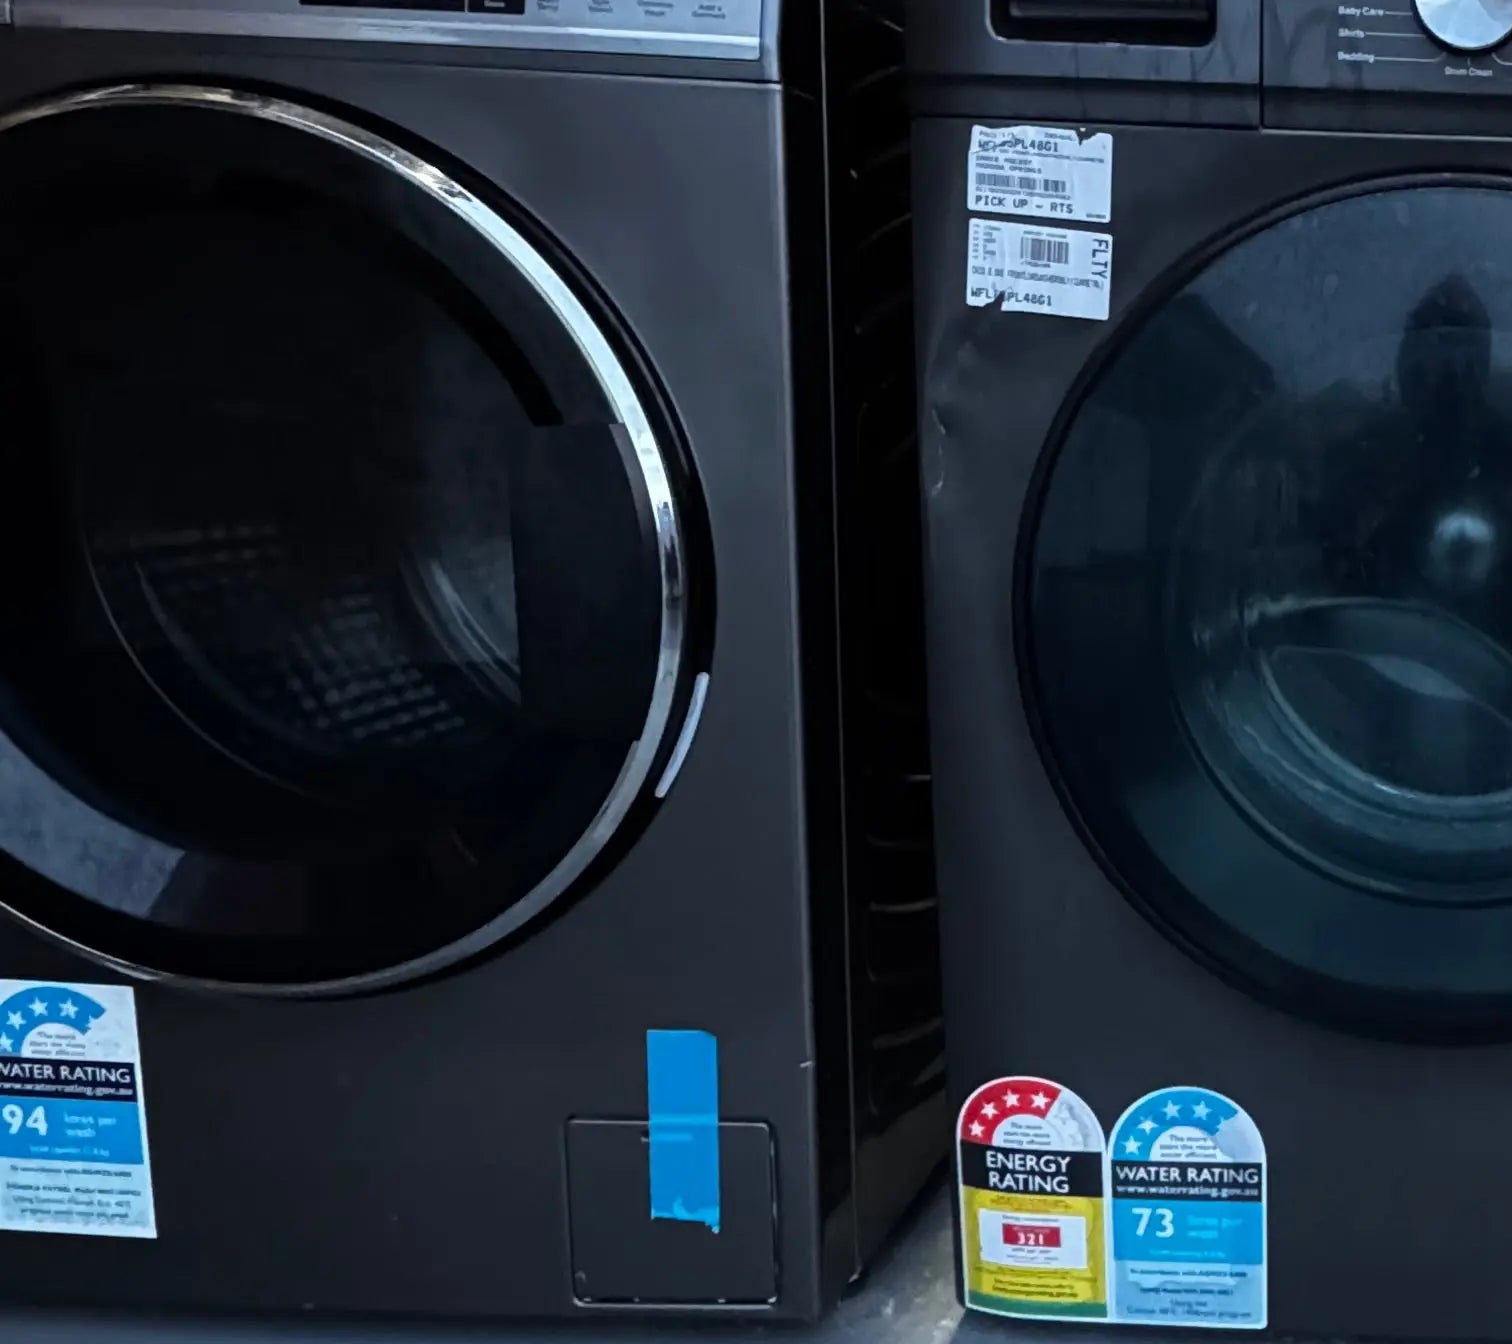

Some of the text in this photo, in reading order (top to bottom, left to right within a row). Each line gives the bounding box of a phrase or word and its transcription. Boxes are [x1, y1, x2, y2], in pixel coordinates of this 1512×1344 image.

[1338, 6, 1384, 17] Baby Care
[975, 195, 1006, 207] PICK
[1013, 199, 1028, 208] UP
[1050, 202, 1073, 214] RTS
[1091, 238, 1109, 279] FLTY
[60, 1065, 131, 1083] RATING
[2, 1104, 48, 1136] 94
[986, 1150, 1071, 1173] ENERGY
[989, 1171, 1069, 1193] RATING
[1116, 1165, 1258, 1184] WATER RATING
[1116, 1185, 1259, 1198] www.waterrating.gov.au
[1131, 1207, 1175, 1238] 73
[1017, 1232, 1044, 1245] 321
